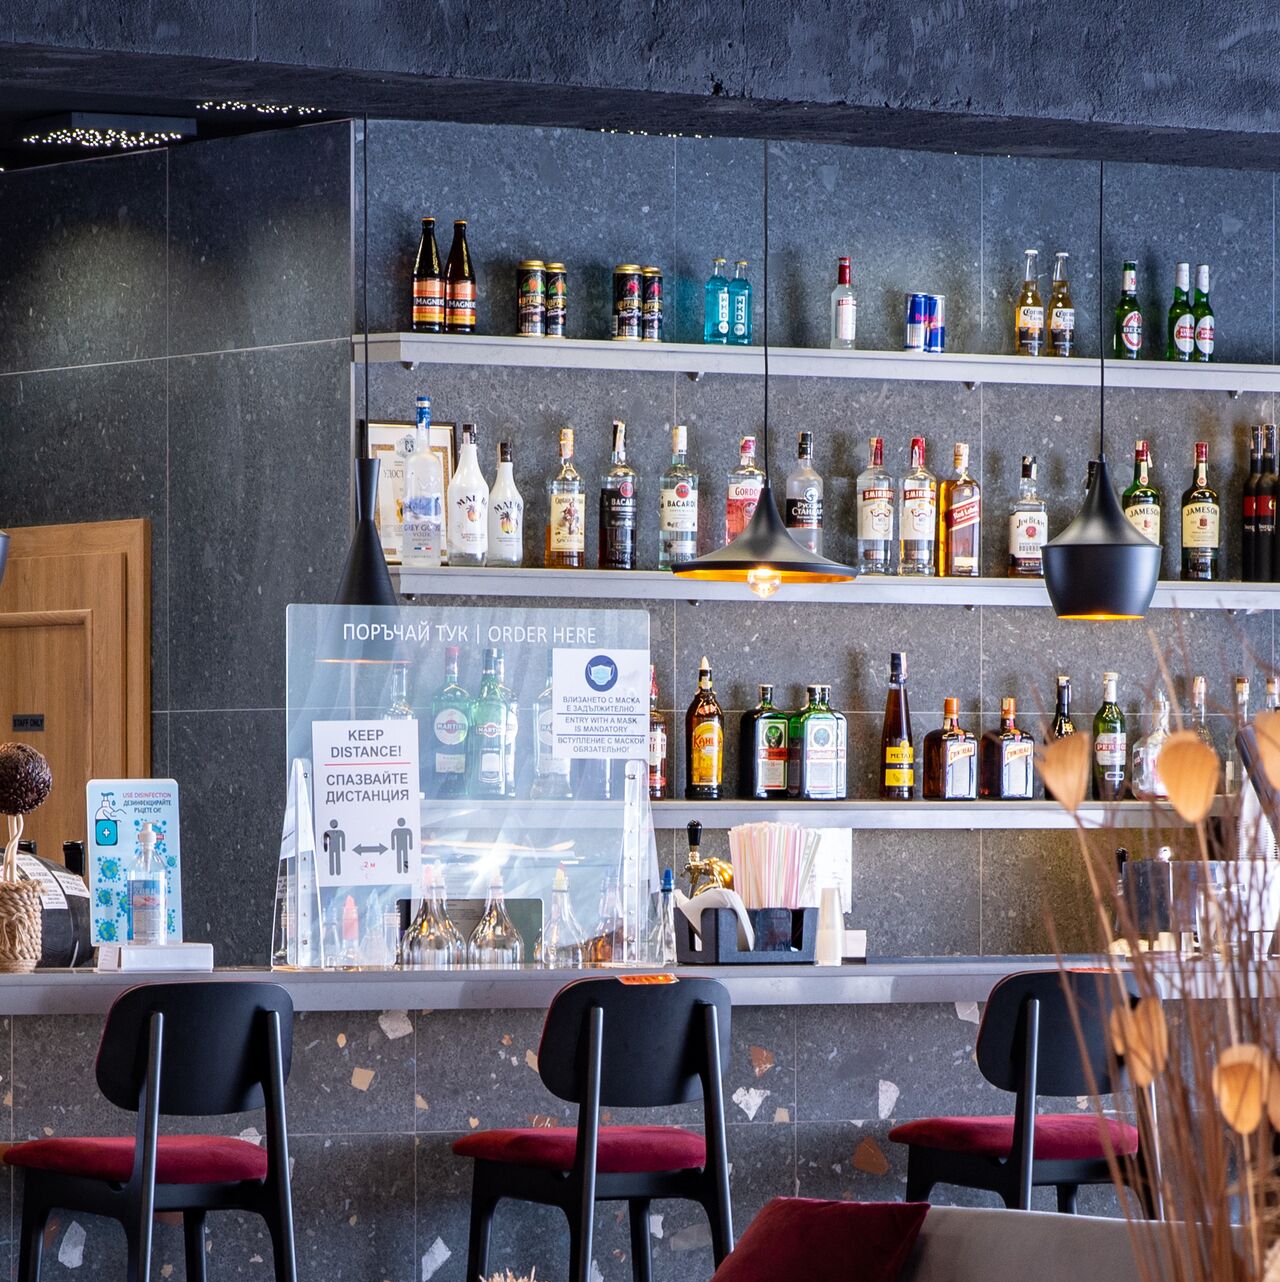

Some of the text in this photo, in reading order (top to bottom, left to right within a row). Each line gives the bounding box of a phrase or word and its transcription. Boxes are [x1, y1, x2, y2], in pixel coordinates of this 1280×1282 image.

[343, 620, 469, 642] ПОРЪЧАЙ ТУК
[488, 625, 597, 644] ORDER HERE
[562, 696, 606, 704] ВЛИЗАНЕТО
[565, 716, 589, 724] ENTRY
[348, 729, 384, 742] KEEP
[557, 736, 606, 744] ВСТУПЛЕНИЕ
[614, 735, 645, 745] МАСКОЙ
[330, 745, 402, 758] DISTANCE!
[326, 770, 408, 786] СПАЗВАЙТЕ
[325, 789, 409, 805] ДИСТАНЦИЯ
